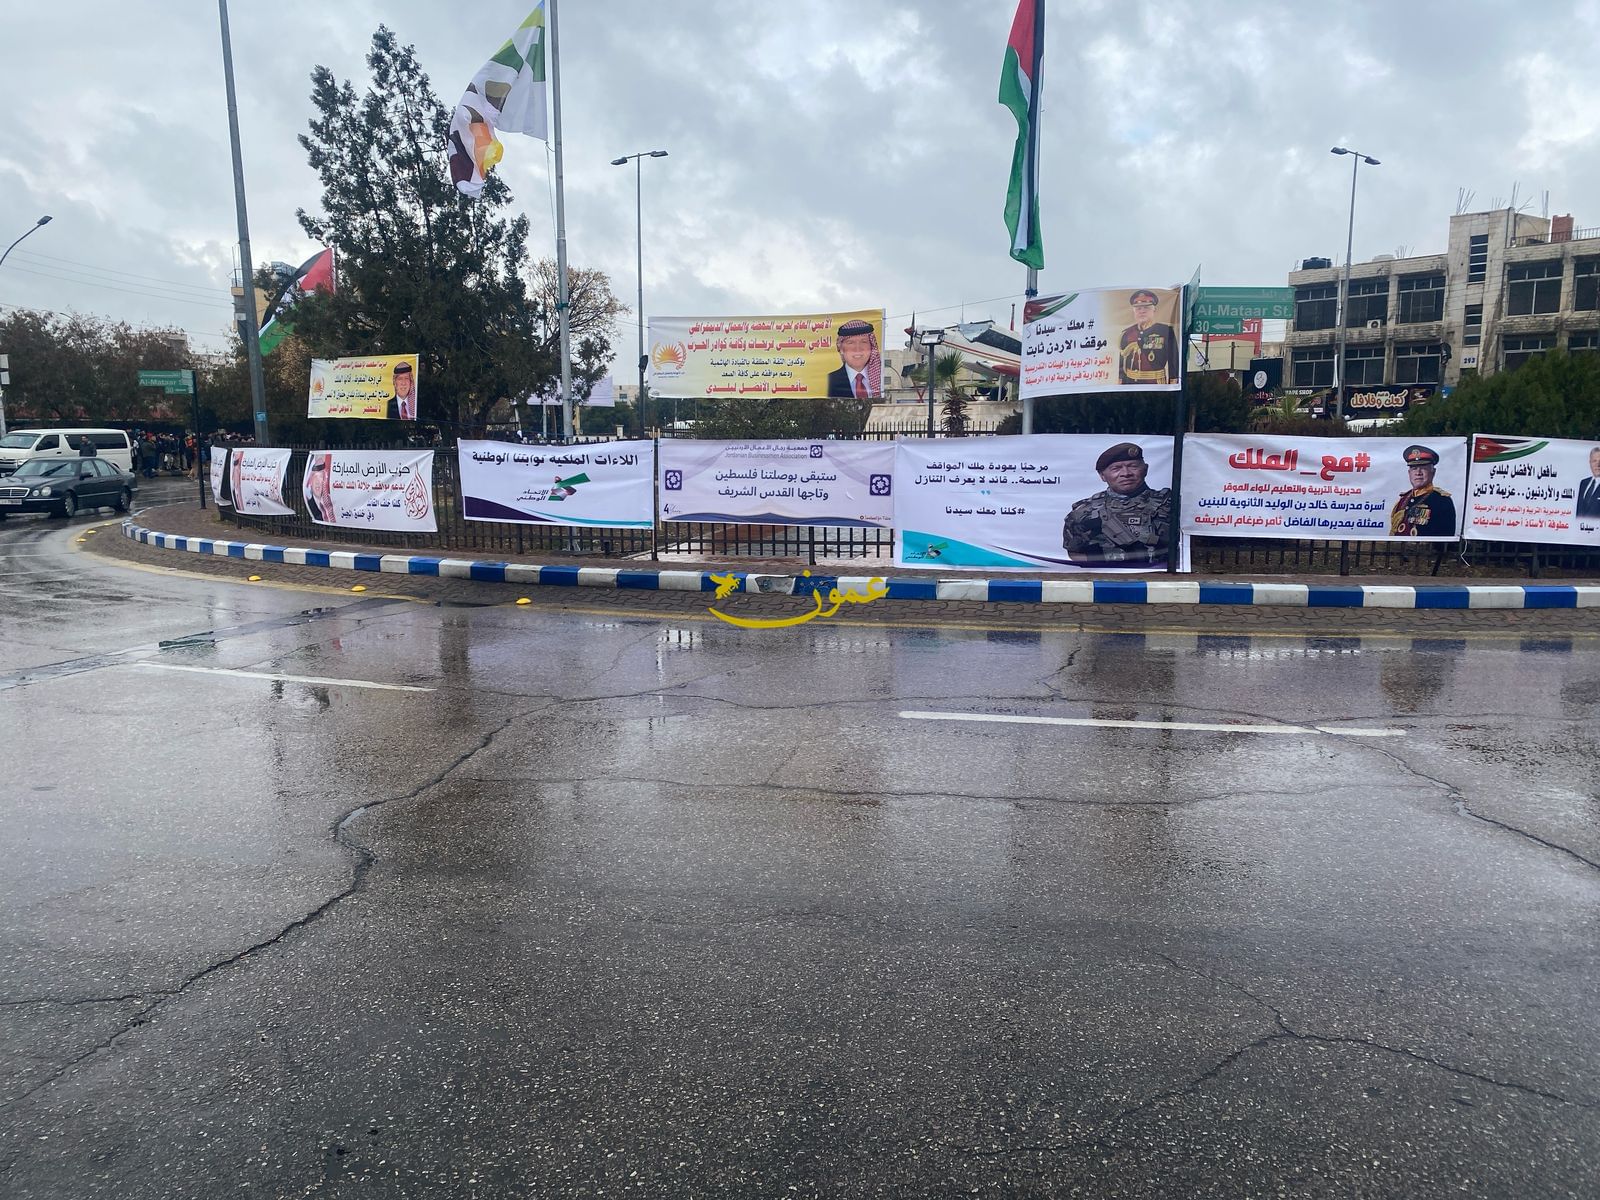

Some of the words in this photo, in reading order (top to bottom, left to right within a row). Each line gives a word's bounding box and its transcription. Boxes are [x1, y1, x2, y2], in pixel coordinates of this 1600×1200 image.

[1197, 305, 1268, 317] Al-Mataar
[1272, 305, 1292, 317] St.
[1036, 324, 1056, 336] سيدنا
[1067, 320, 1084, 330] معك
[1196, 321, 1209, 332] 30
[1080, 336, 1107, 350] موقف
[1026, 342, 1044, 358] ثابت
[1071, 357, 1092, 368] التربوية
[1094, 356, 1112, 366] الأسرة
[1046, 374, 1055, 382] لواء
[1057, 372, 1071, 381] تربية
[1072, 372, 1082, 382] في
[1351, 393, 1382, 408] وفلافل
[1385, 389, 1408, 407] كعك
[472, 451, 508, 465] الوطنية
[595, 454, 638, 466] اللاءات
[333, 462, 359, 476] المباركة
[362, 462, 386, 476] الأرض
[389, 463, 410, 477] حزب
[927, 462, 965, 472] المواقف
[967, 462, 985, 471] ملك
[988, 462, 1018, 472] بعودة
[1490, 465, 1509, 478] لبلدي
[1511, 464, 1535, 478] الأفضل
[1537, 464, 1557, 479] سأفعل
[715, 468, 758, 481] فلسطين
[761, 469, 797, 483] بوصلتنا
[801, 470, 836, 483] ستبقى
[915, 474, 946, 485] التنازل
[978, 476, 985, 484] لا
[987, 476, 1007, 484] قائد
[358, 480, 370, 492] جلالة
[949, 476, 976, 486] يعرف
[372, 482, 390, 492] مواقف
[392, 485, 405, 493] يدعم
[718, 486, 756, 498] الشريف
[1222, 483, 1248, 493] الموقر
[1250, 484, 1269, 492] للواء
[1270, 484, 1307, 495] والتعليم
[1308, 485, 1332, 496] التربية
[1334, 486, 1361, 496] مديرية
[1473, 482, 1487, 497] تلين
[1489, 483, 1495, 495] لا
[1496, 483, 1516, 499] عزيمة
[759, 488, 794, 500] القدس
[797, 488, 828, 500] وتاجها
[1561, 489, 1575, 499] الملك
[380, 499, 390, 507] خلف
[1198, 497, 1228, 508] للبنين
[1230, 497, 1263, 510] الثانوية
[1265, 499, 1293, 511] الوليد
[1295, 501, 1307, 511] بن
[1308, 500, 1328, 510] خالد
[1331, 500, 1362, 512] مدرسة
[1365, 500, 1385, 512] أسرة
[1474, 504, 1493, 512] الرصيفة
[945, 506, 972, 516] سيدنا
[976, 506, 996, 515] معك
[1507, 505, 1525, 514] والتعليم
[1526, 506, 1542, 514] التربية
[1543, 506, 1560, 516] مديرية
[1560, 508, 1572, 516] مدير
[1194, 515, 1232, 526] الخريشه
[1234, 515, 1264, 527] ضرغام
[1266, 517, 1282, 527] ثامر
[1284, 516, 1316, 528] الفاضل
[1318, 517, 1355, 530] بمديرها
[1357, 517, 1384, 529] ممثلة
[1473, 516, 1504, 527] الشديفات
[1507, 517, 1522, 527] أحمد
[1525, 518, 1546, 528] الأستاذ
[1548, 519, 1569, 530] عطوفة
[1580, 522, 1594, 533] سيدنا
